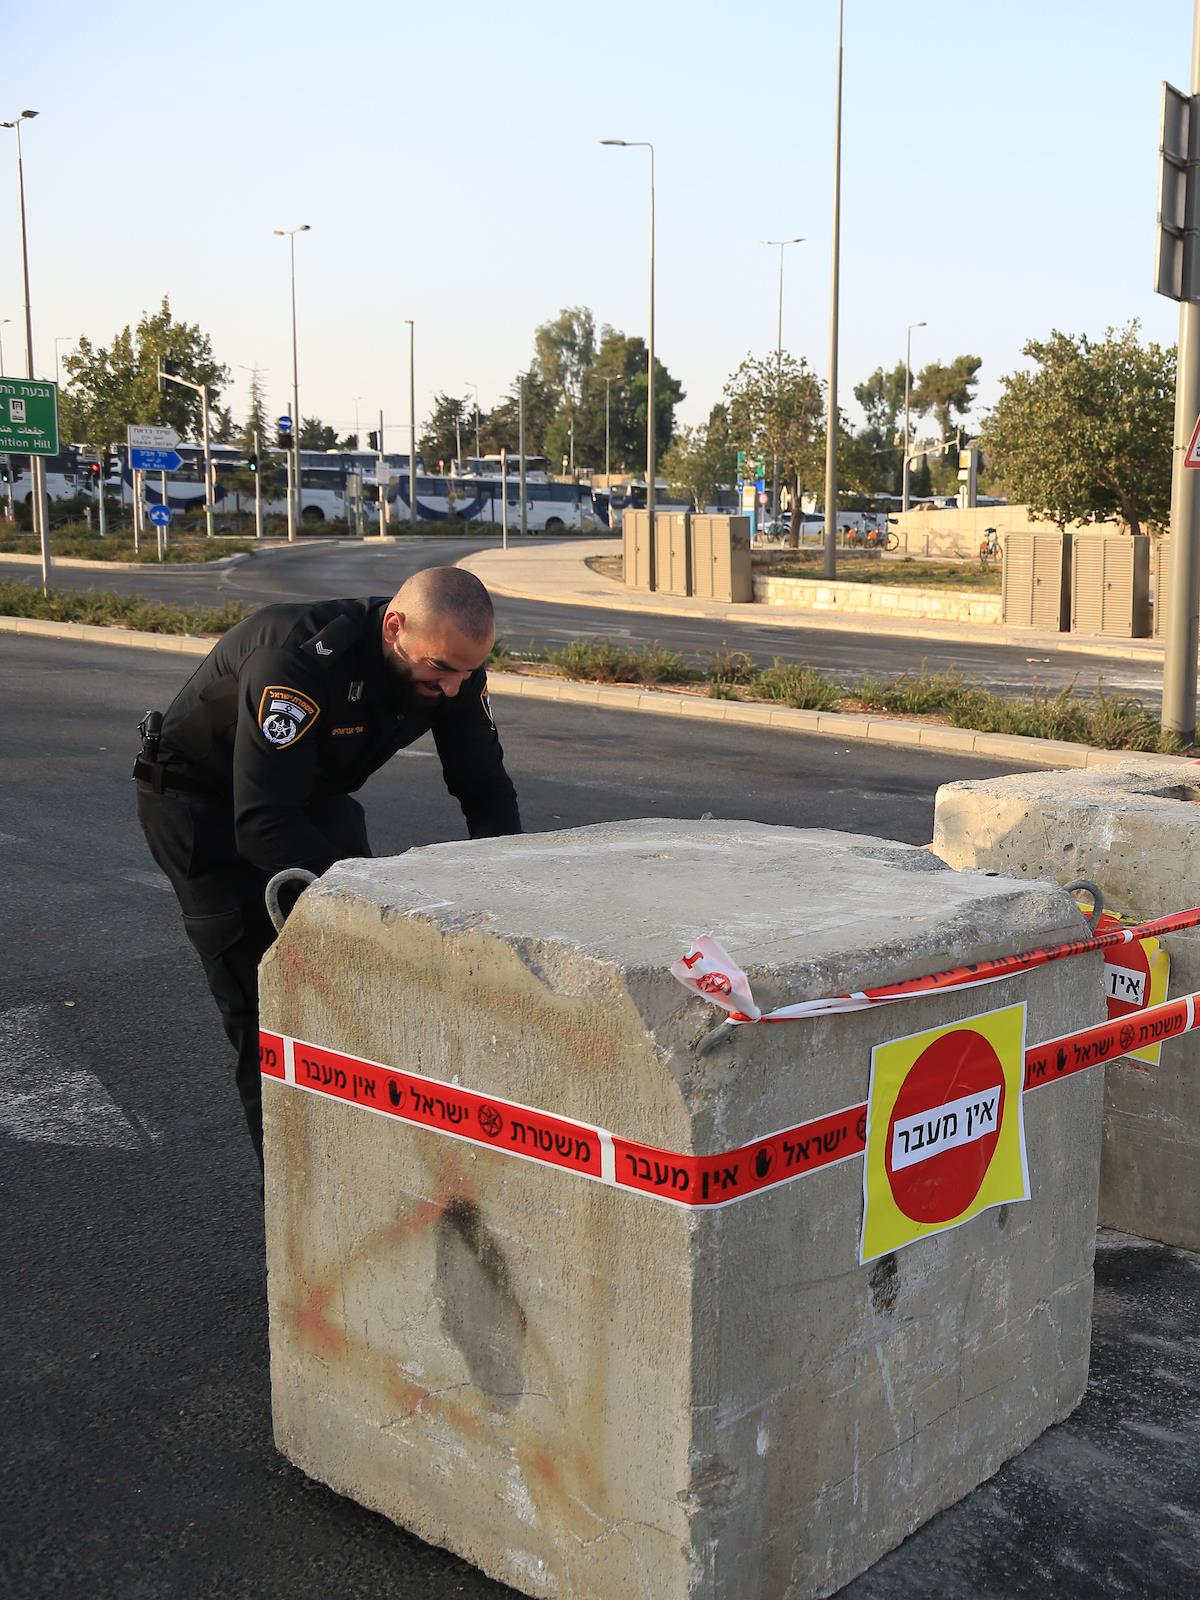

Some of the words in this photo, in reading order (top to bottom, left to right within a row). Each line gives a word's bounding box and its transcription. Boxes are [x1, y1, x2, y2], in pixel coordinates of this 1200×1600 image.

[21, 386, 50, 397] גבעת
[34, 439, 51, 448] Hill
[1111, 972, 1141, 997] אין
[1138, 1014, 1183, 1042] משטרת
[1073, 1037, 1114, 1064] ישראל
[302, 1058, 346, 1088] מעבר
[353, 1074, 376, 1098] אין
[1026, 1059, 1047, 1086] אין
[410, 1086, 469, 1124] ישראל
[966, 1098, 995, 1137] אין
[510, 1121, 591, 1163] משטרת
[783, 1127, 847, 1167] ישראל
[898, 1113, 957, 1154] מעבר
[626, 1153, 689, 1192] מעבר
[702, 1165, 738, 1199] אין
